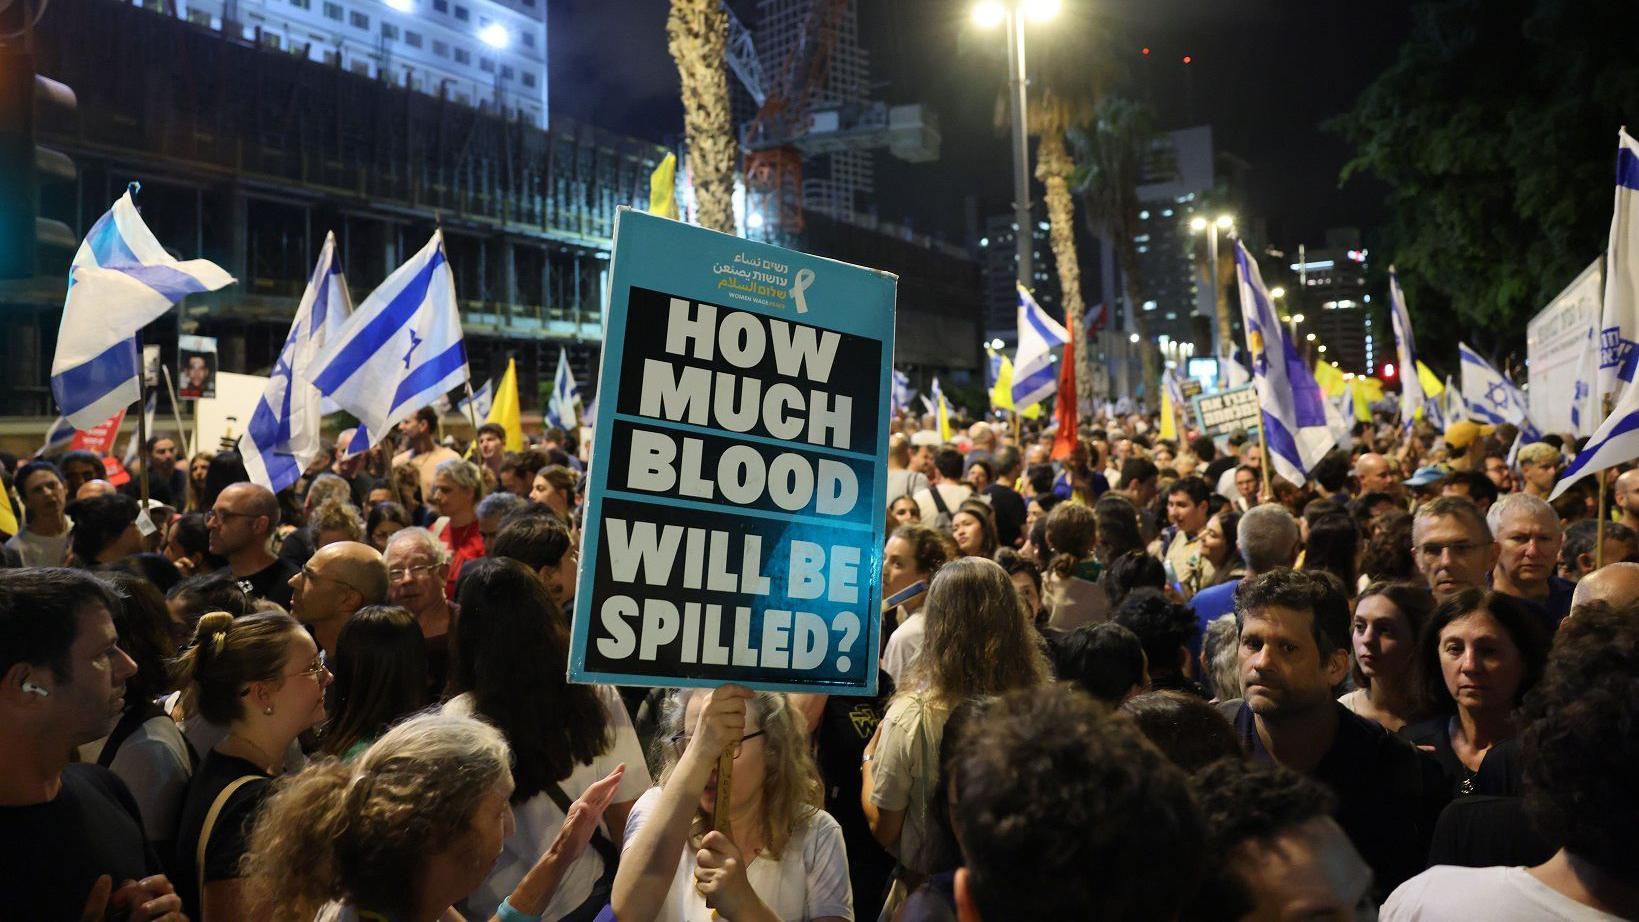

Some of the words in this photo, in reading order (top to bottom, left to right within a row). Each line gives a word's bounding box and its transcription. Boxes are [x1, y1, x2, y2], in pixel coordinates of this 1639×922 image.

[734, 252, 760, 267] نساء
[763, 260, 788, 274] נשים
[713, 262, 751, 281] يصنعن
[752, 270, 788, 286] עושות
[718, 277, 757, 293] السلام
[758, 284, 787, 300] שלום
[729, 292, 752, 303] WOMEN
[666, 298, 841, 383] HOW
[640, 359, 852, 449] MUCH
[627, 429, 858, 515] BLOOD
[606, 518, 770, 595] WILL
[788, 540, 860, 603] BE
[597, 595, 860, 672] SPILLED?
